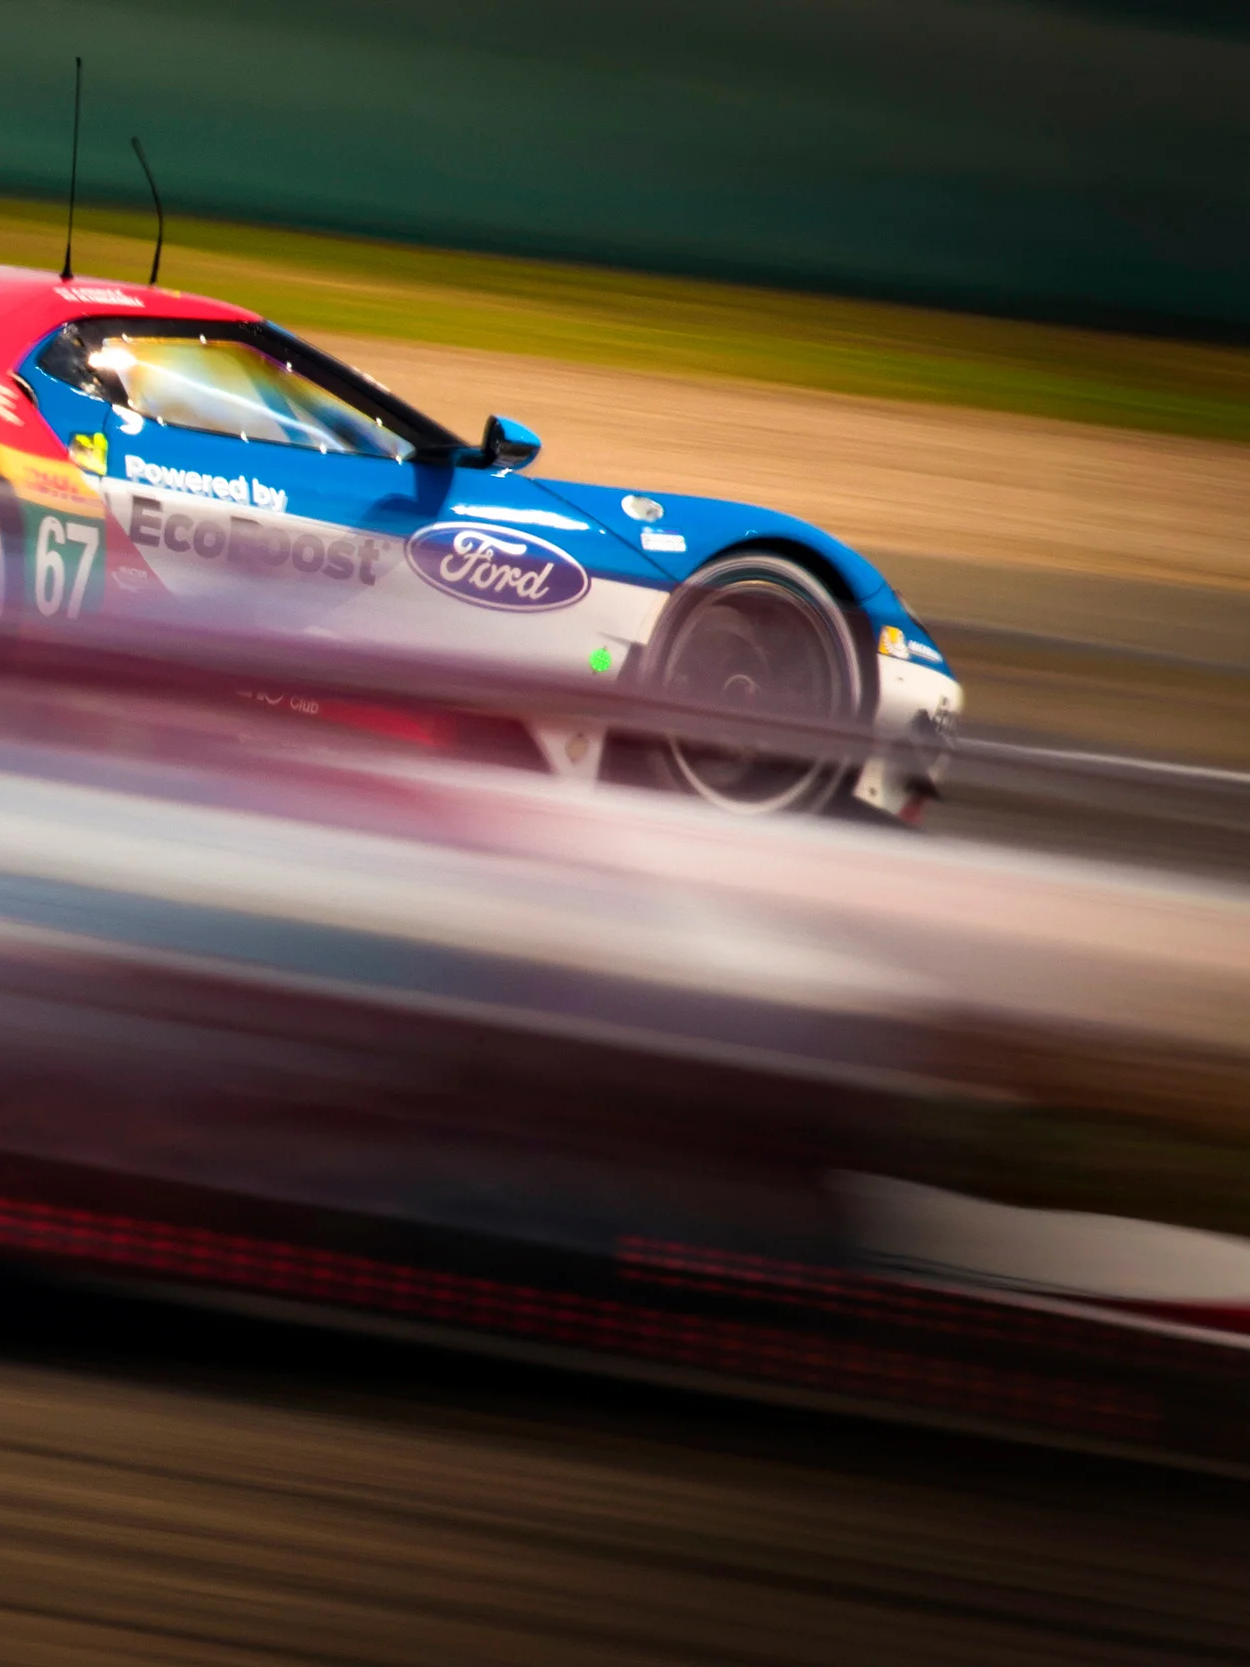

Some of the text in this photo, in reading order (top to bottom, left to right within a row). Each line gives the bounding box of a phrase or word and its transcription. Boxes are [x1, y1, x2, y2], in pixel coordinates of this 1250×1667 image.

[124, 454, 250, 504] Powered
[252, 478, 288, 513] by
[35, 515, 100, 620] 67
[129, 494, 381, 587] EcoBoost
[439, 530, 555, 601] Ford
